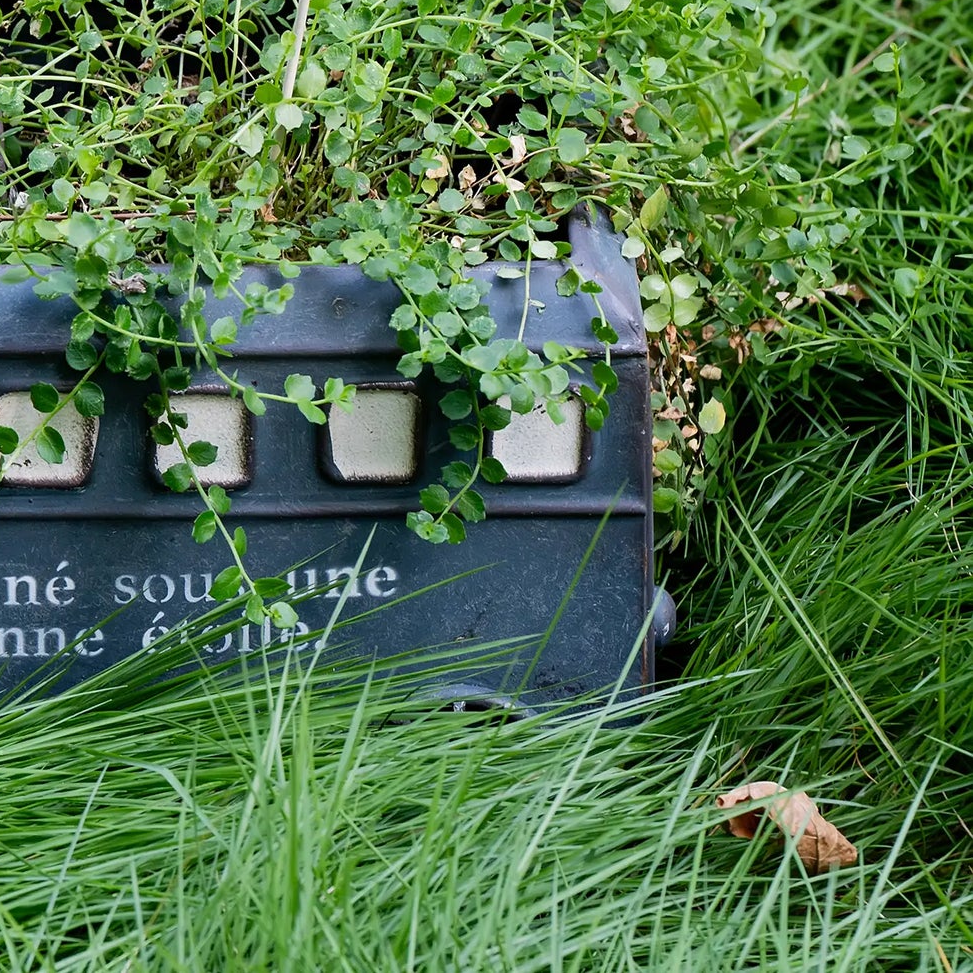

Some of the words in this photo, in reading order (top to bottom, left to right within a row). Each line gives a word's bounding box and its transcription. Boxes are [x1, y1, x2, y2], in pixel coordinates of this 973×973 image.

[3, 560, 76, 606] né
[114, 574, 246, 604] sou
[286, 566, 398, 598] une
